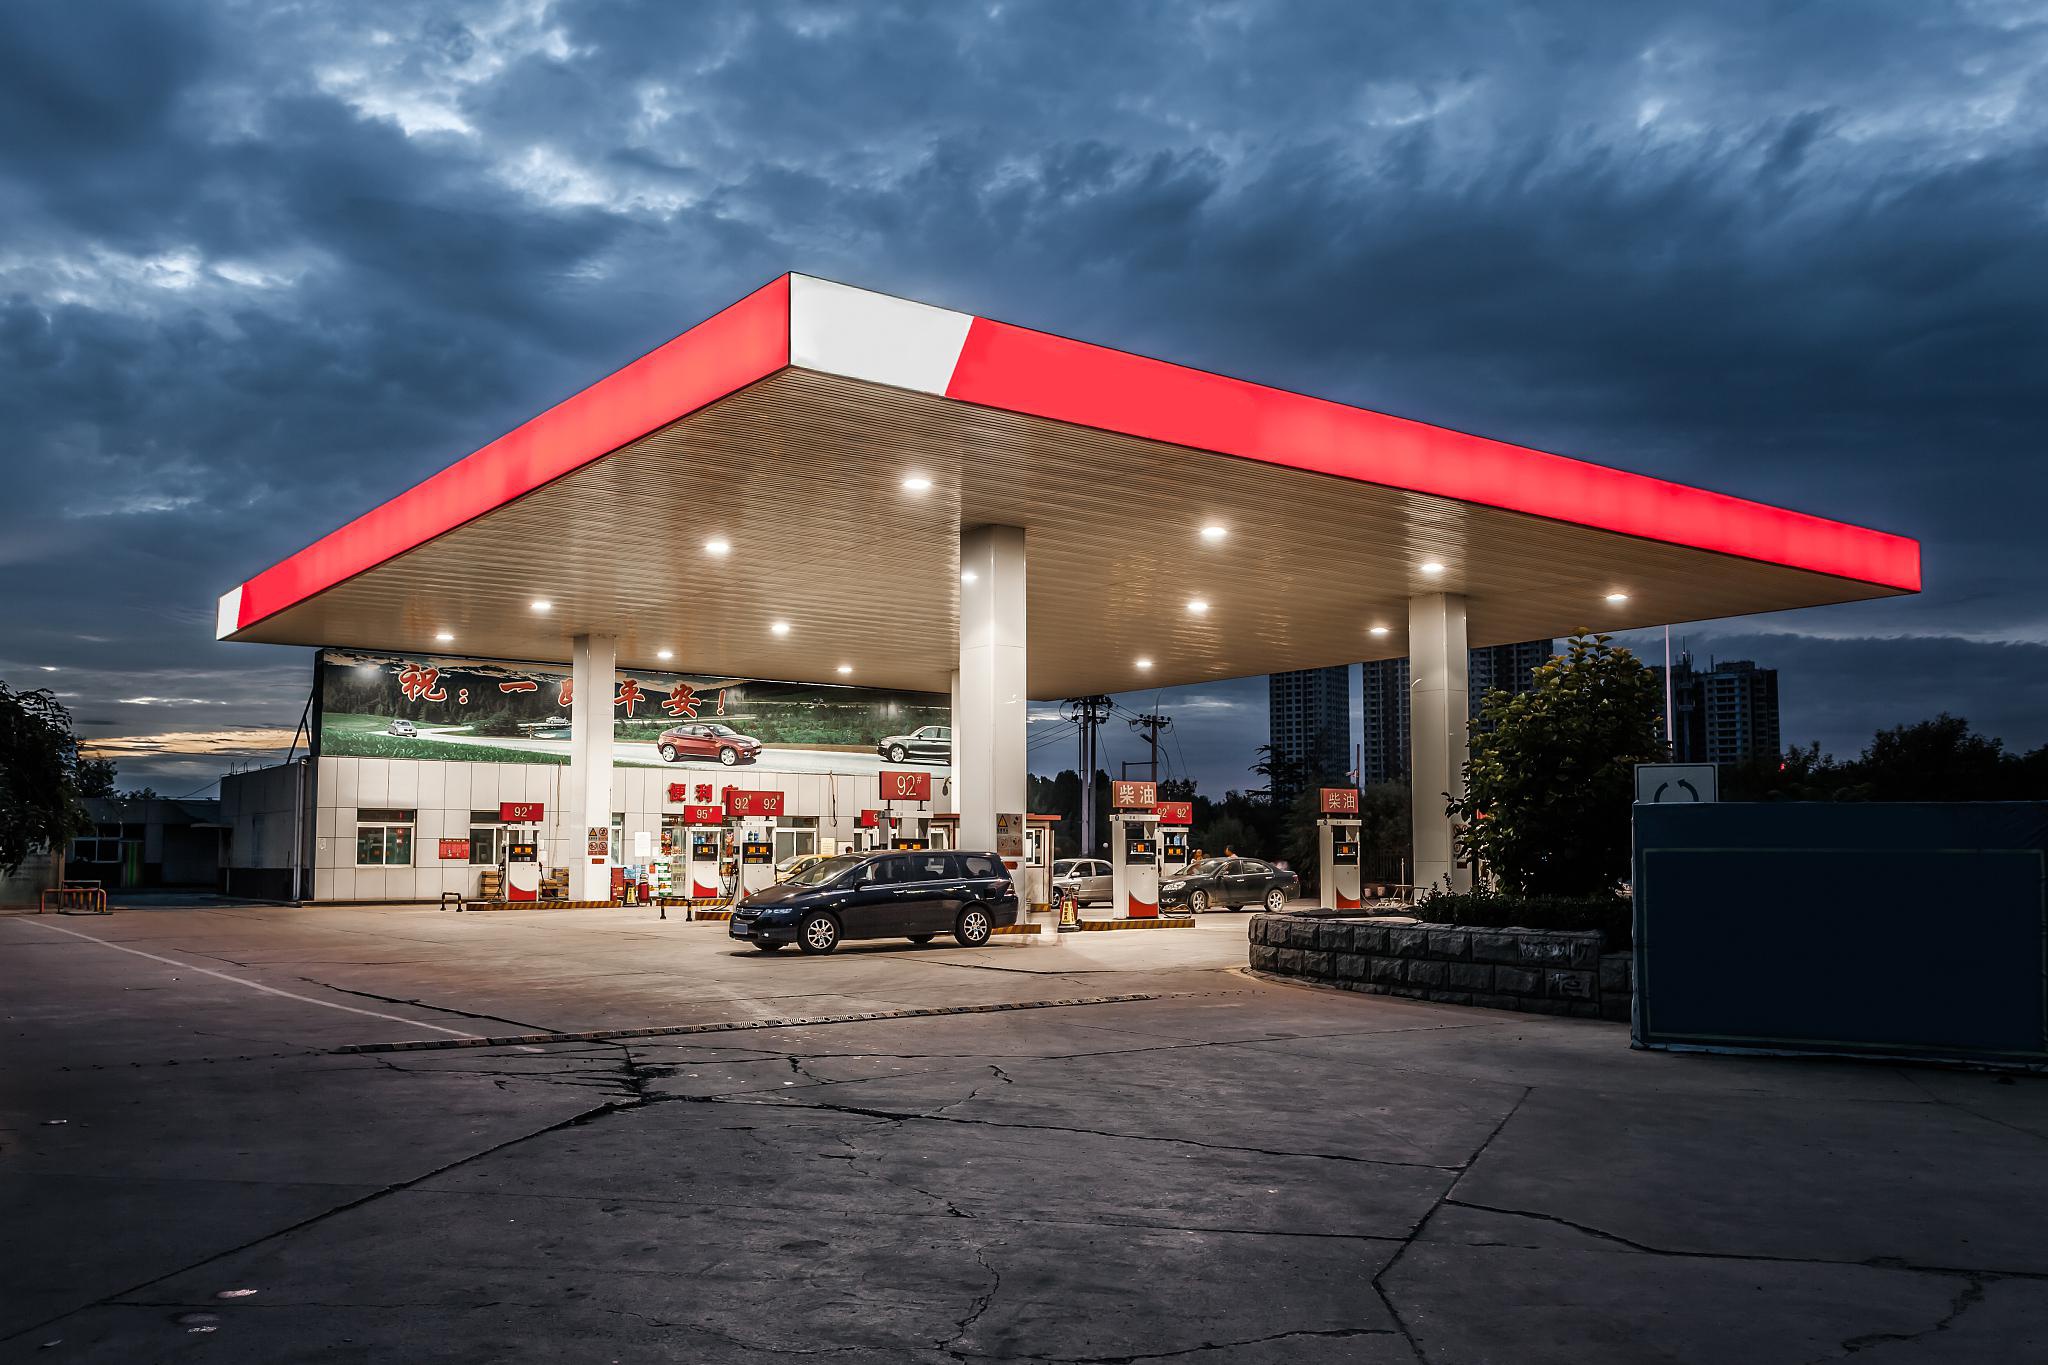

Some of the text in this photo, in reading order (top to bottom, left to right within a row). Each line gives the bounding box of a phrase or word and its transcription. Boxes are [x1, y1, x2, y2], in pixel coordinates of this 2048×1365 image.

[897, 775, 922, 796] 92#
[1119, 784, 1155, 805] 柴油
[1328, 792, 1355, 809] 柴油
